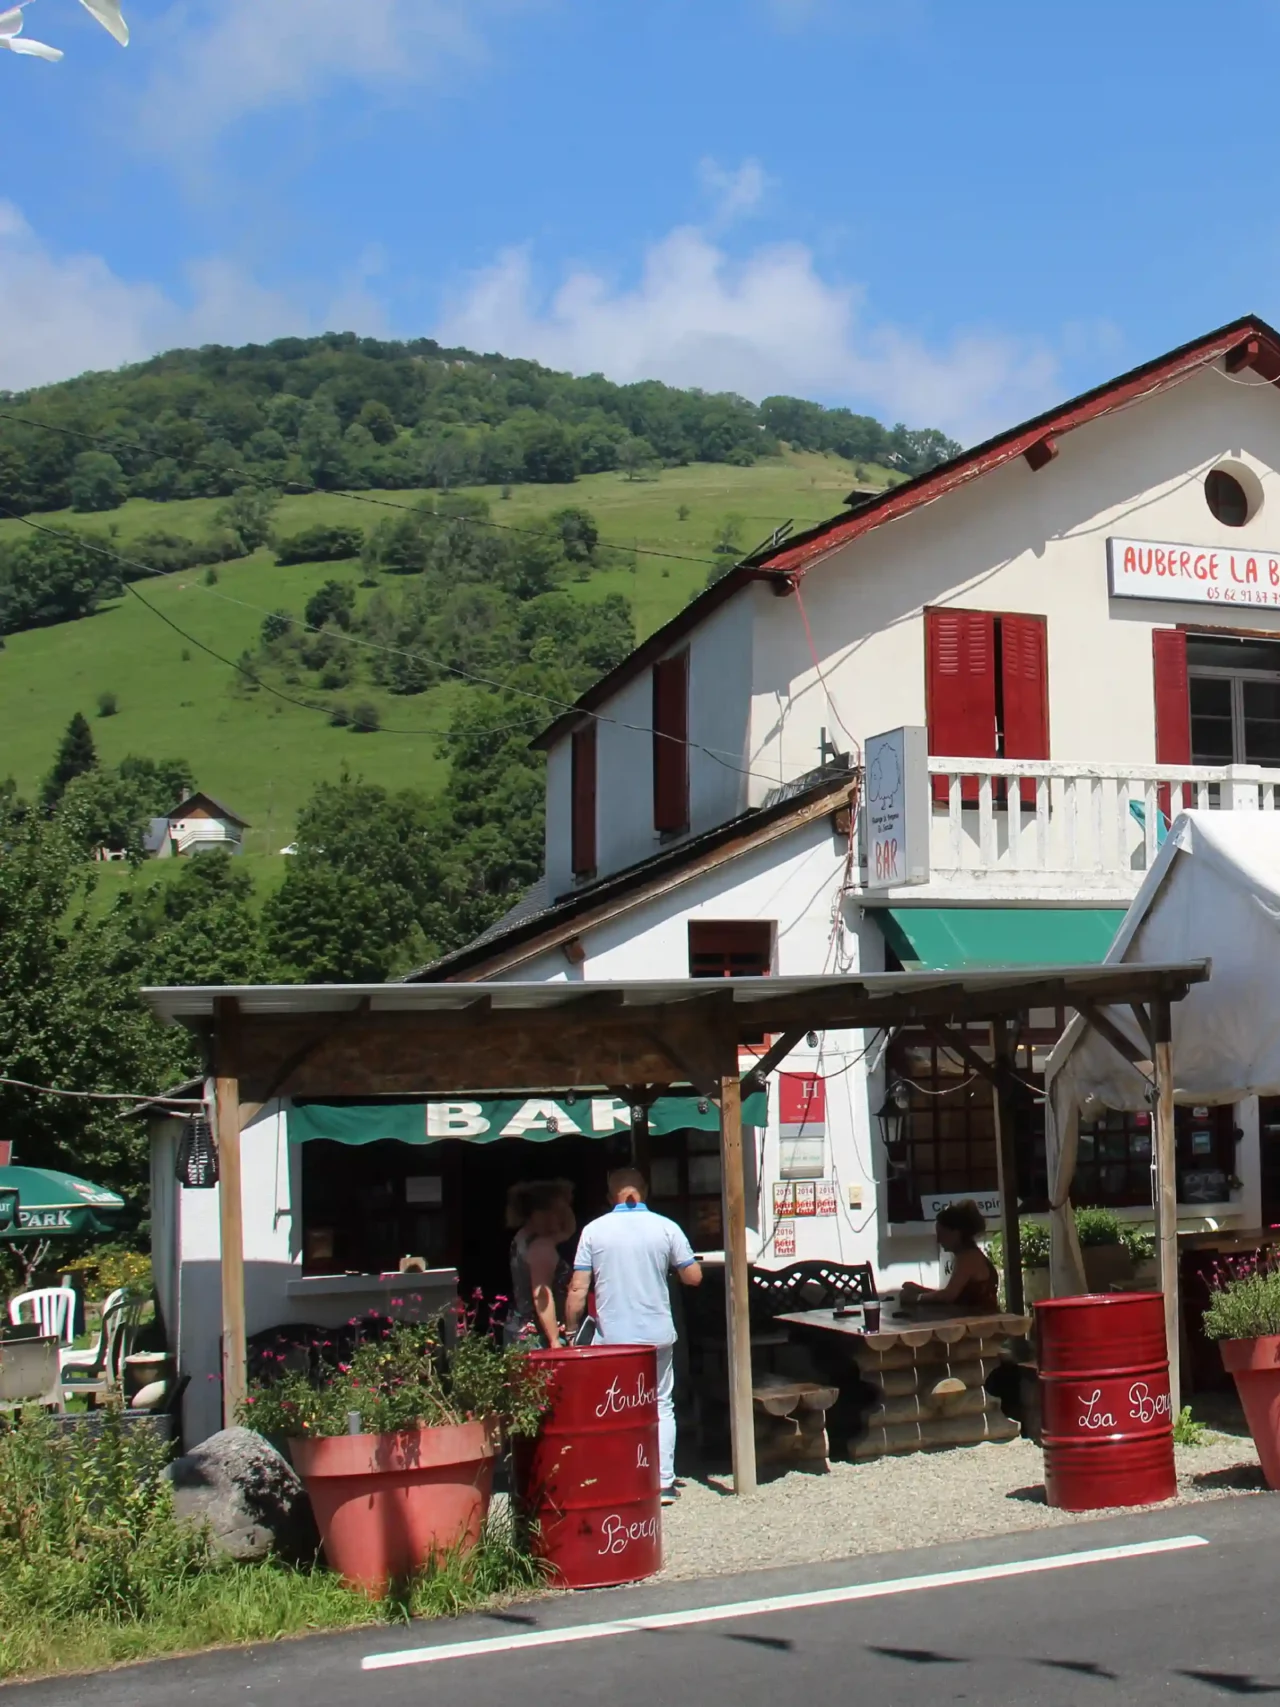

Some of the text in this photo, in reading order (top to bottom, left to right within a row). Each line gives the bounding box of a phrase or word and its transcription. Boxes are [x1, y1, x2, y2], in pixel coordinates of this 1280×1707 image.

[1124, 546, 1219, 581] AUBERGE
[1230, 556, 1258, 584] LA
[1207, 586, 1220, 599] 05
[1224, 587, 1236, 601] 62
[1240, 589, 1252, 602] 91
[1256, 590, 1267, 603] 87
[875, 838, 898, 880] BAR
[801, 1080, 819, 1099] H
[426, 1097, 656, 1136] BAR
[797, 1187, 813, 1195] 2014
[19, 1210, 73, 1227] PARK
[776, 1228, 793, 1236] 2016
[1078, 1388, 1117, 1429] La
[636, 1443, 650, 1468] la
